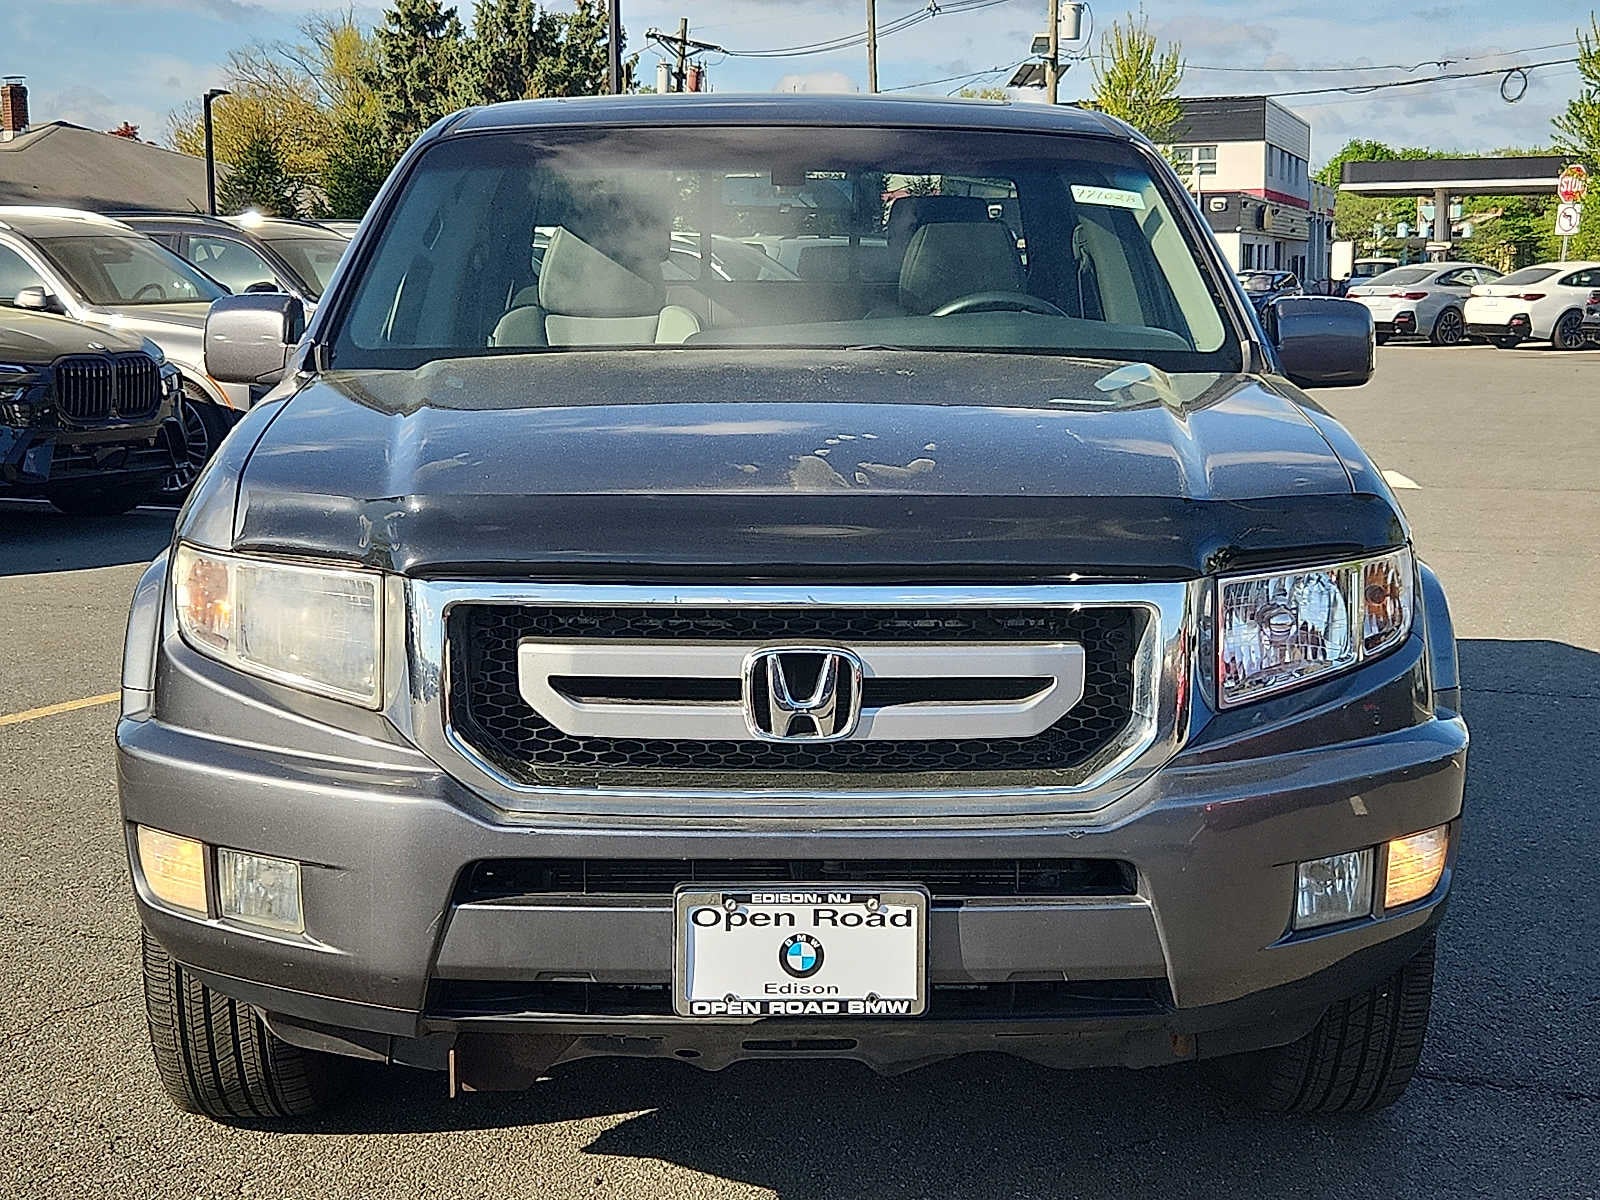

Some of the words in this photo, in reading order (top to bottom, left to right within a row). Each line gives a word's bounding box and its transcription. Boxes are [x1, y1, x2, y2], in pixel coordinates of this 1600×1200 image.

[751, 893, 823, 904] EDISON,
[827, 893, 851, 904] NJ
[691, 907, 796, 932] Open
[812, 908, 913, 927] Road
[784, 934, 822, 949] BMW
[764, 983, 839, 995] Edison
[692, 1001, 761, 1015] OPEN
[768, 1001, 840, 1015] ROAD
[848, 1001, 909, 1014] BMW
